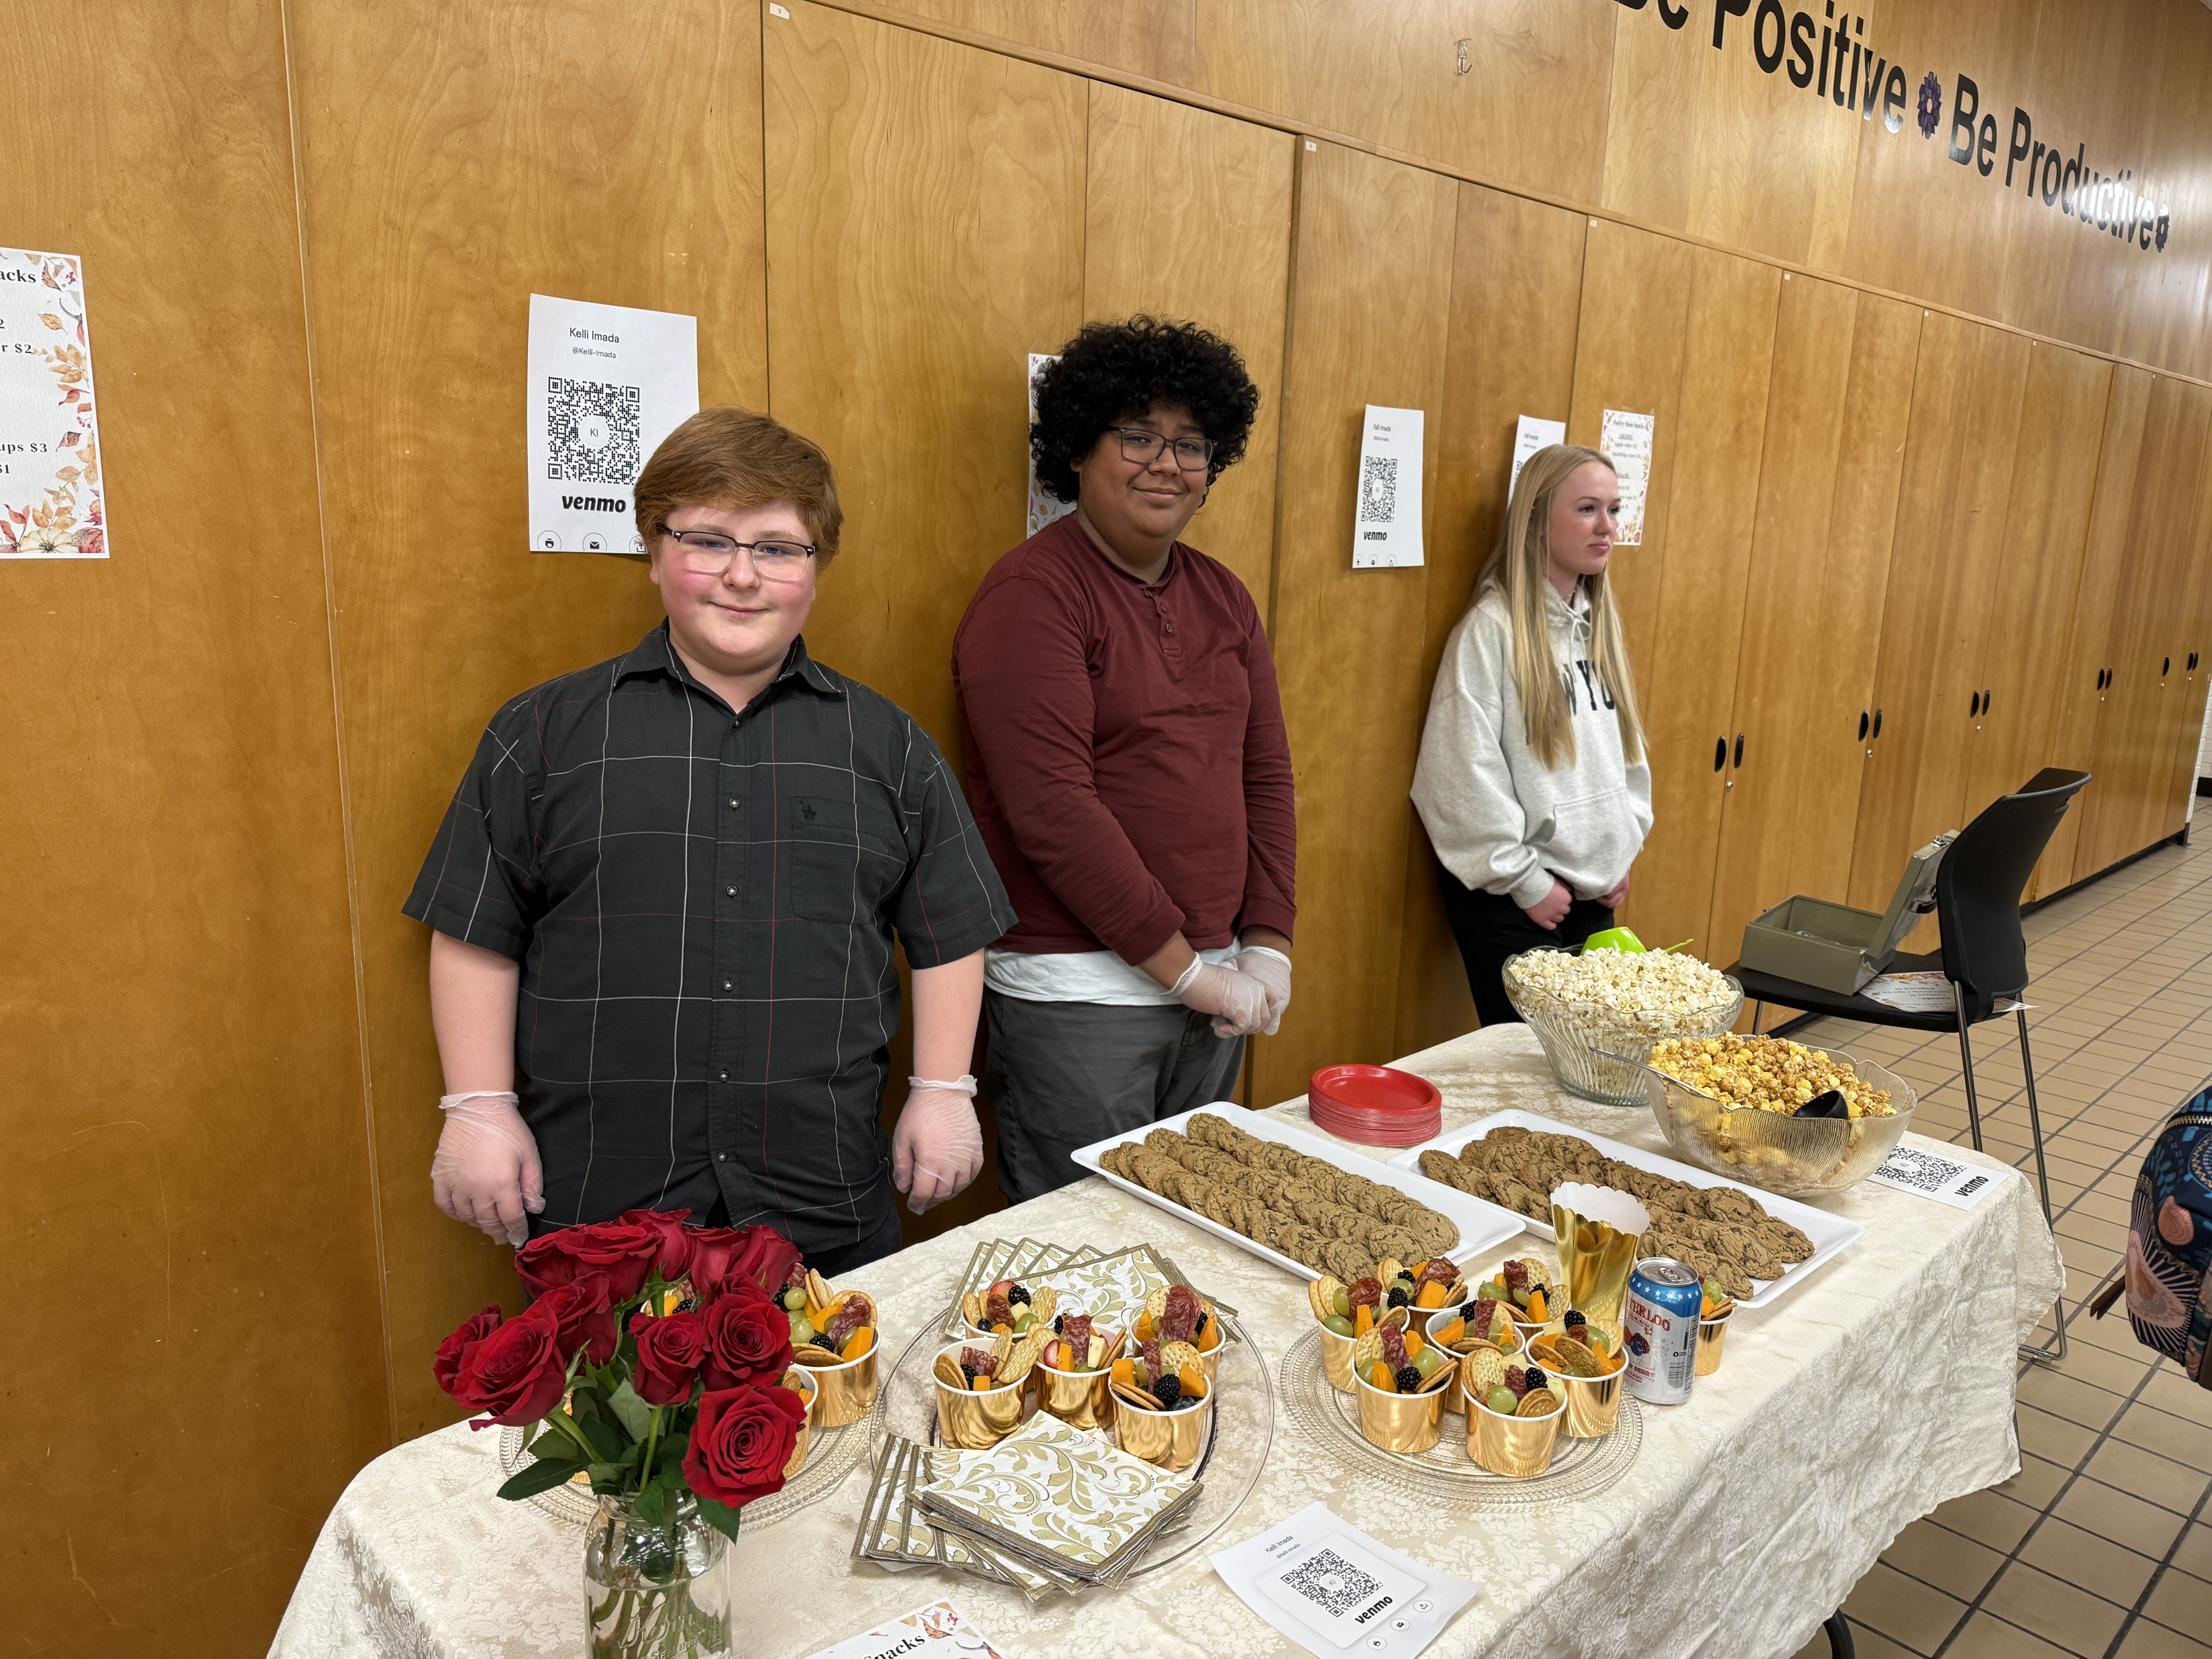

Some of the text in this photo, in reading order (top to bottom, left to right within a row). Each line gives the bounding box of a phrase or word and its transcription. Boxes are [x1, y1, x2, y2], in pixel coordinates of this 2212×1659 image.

[1949, 73, 1997, 177] Be
[2006, 106, 2155, 250] Productive
[570, 327, 620, 343] Kelli Imada
[15, 343, 32, 354] $2
[572, 347, 617, 359] @Kelli-Imada
[590, 428, 598, 437] KI
[30, 443, 47, 453] $3
[562, 496, 627, 513] venmo
[1364, 531, 1387, 541] venmo
[1954, 1176, 1989, 1197] venmo
[1264, 1535, 1293, 1553] Kelli Imada
[1355, 1596, 1393, 1624] venmo
